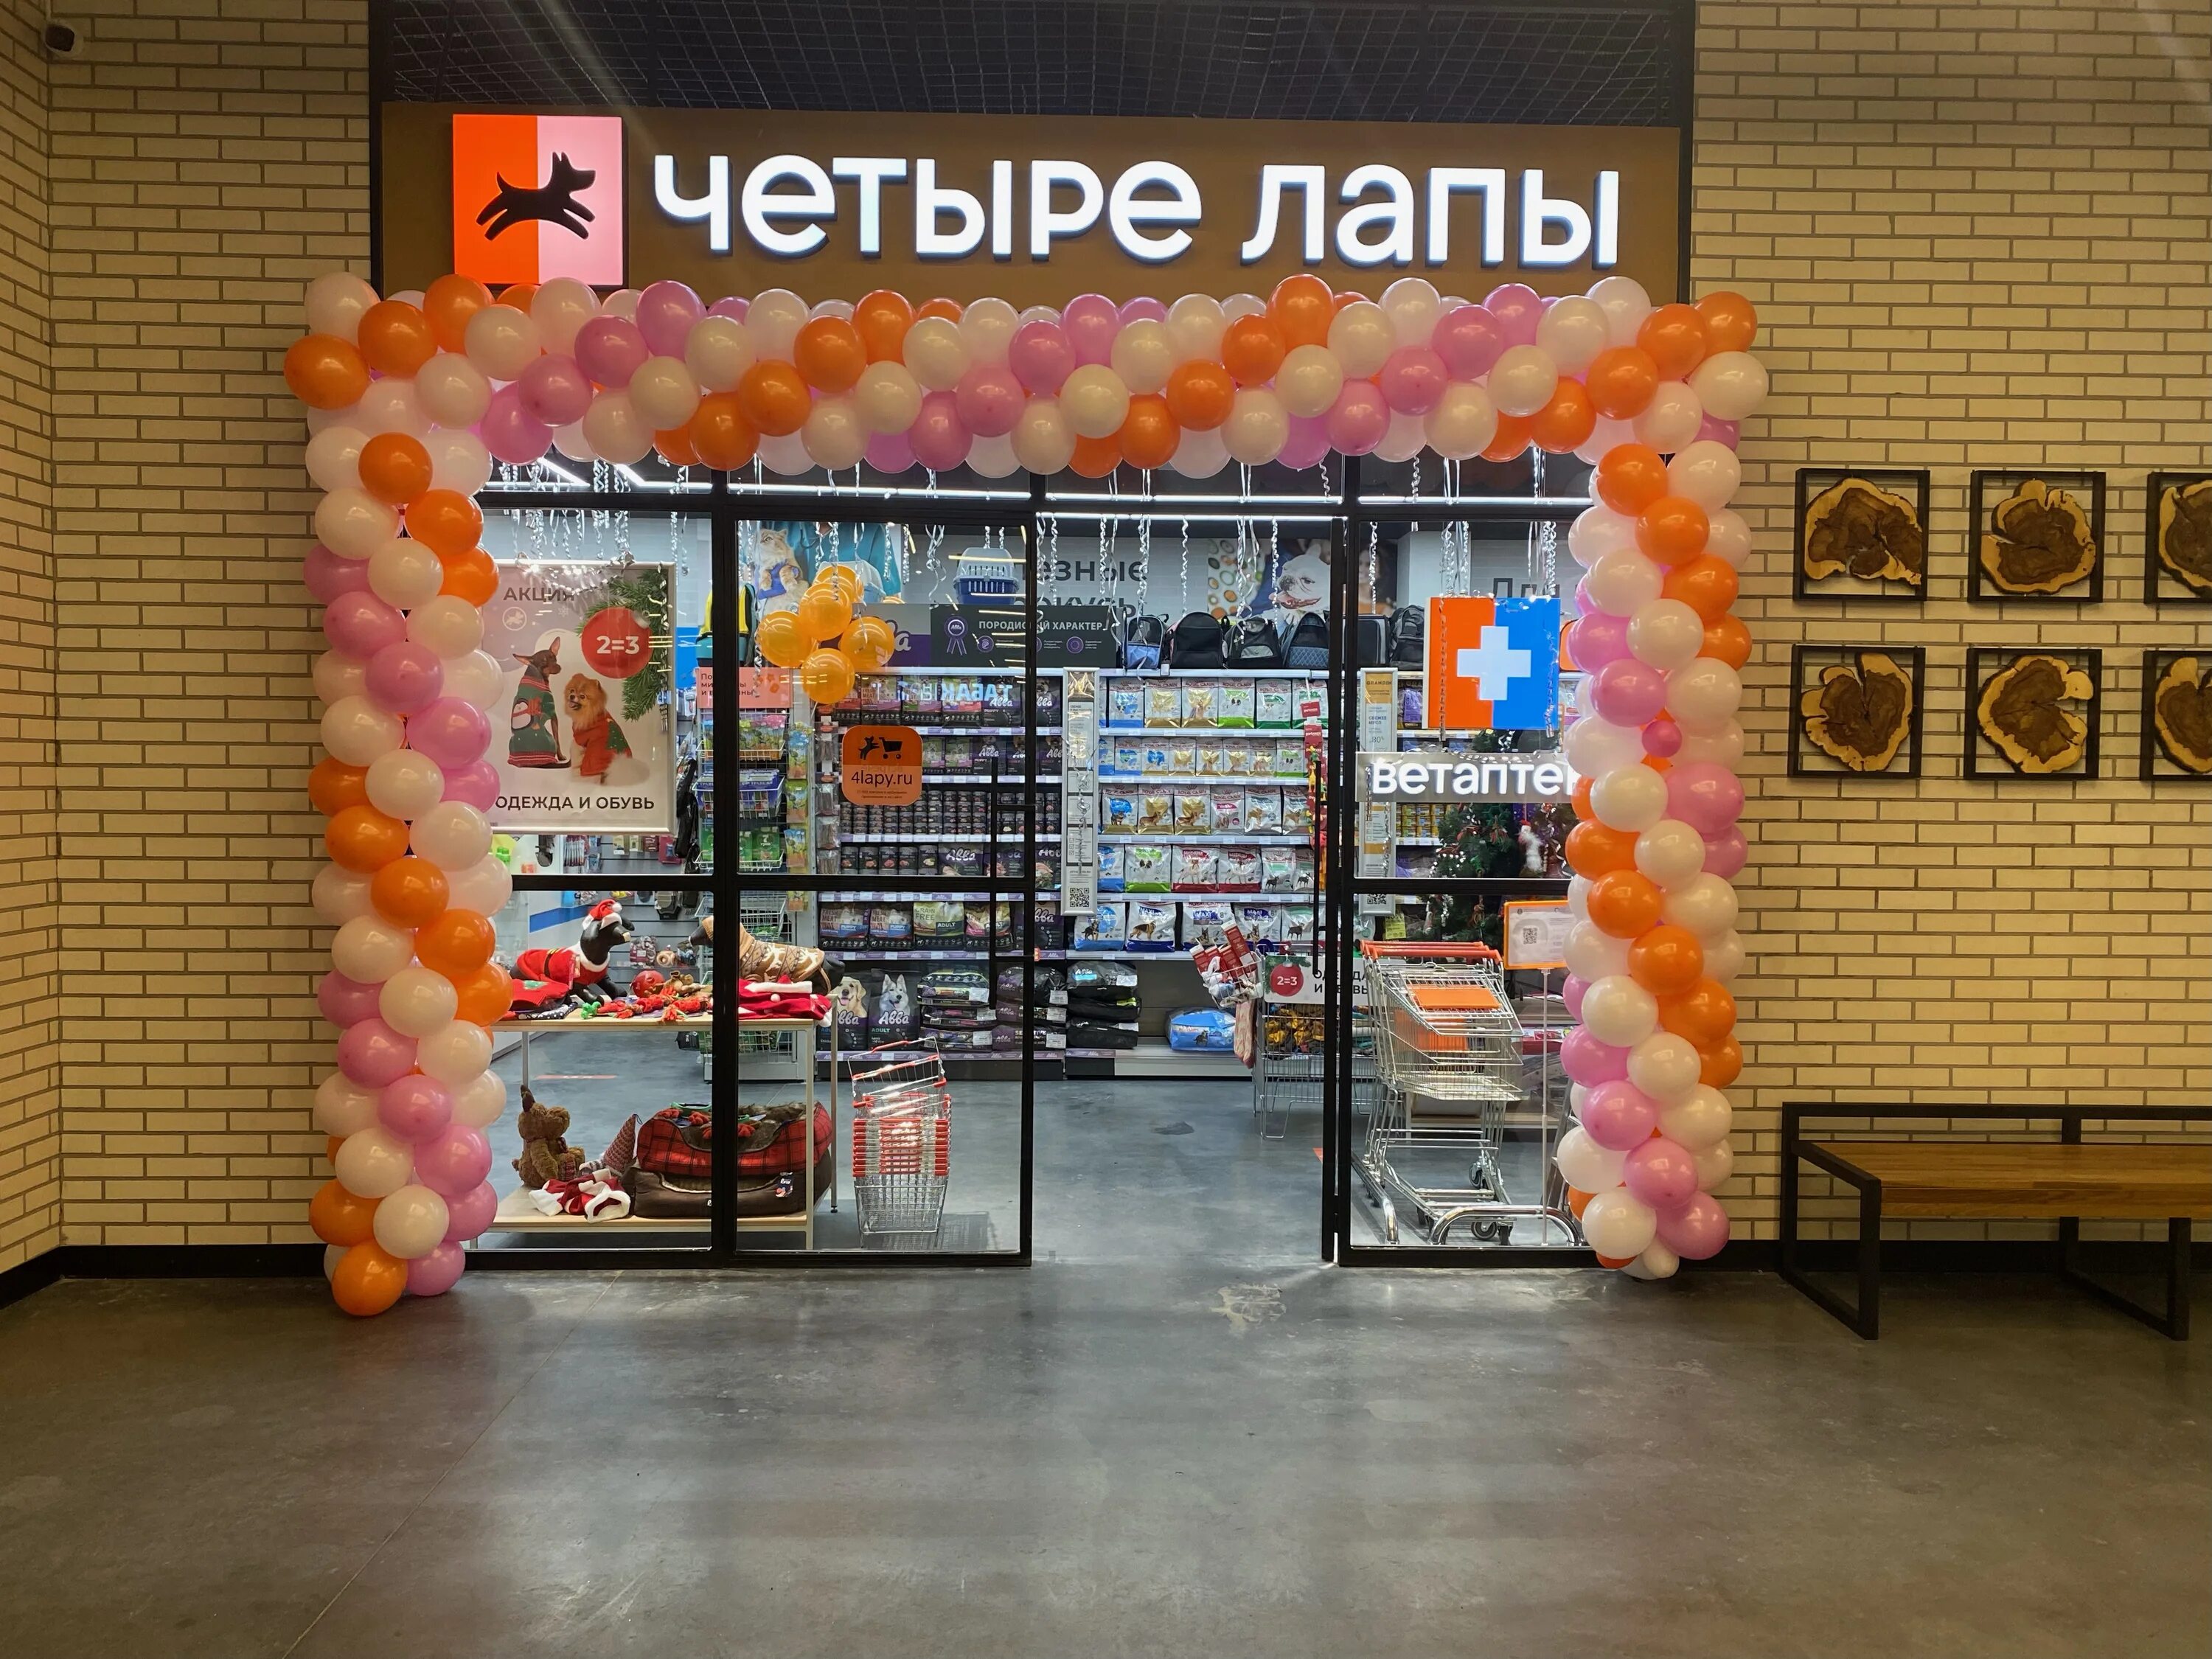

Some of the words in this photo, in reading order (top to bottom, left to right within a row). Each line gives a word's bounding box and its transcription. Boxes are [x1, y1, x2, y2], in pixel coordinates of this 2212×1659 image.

[503, 587, 575, 602] АКЦИЯ
[1052, 622, 1103, 630] ХАРАКТЕР
[596, 635, 640, 655] 2=3
[851, 769, 913, 787] 4lapy.ru
[495, 796, 574, 811] ОДЕЖДА
[579, 796, 591, 810] И
[596, 796, 655, 810] ОБУВЬ
